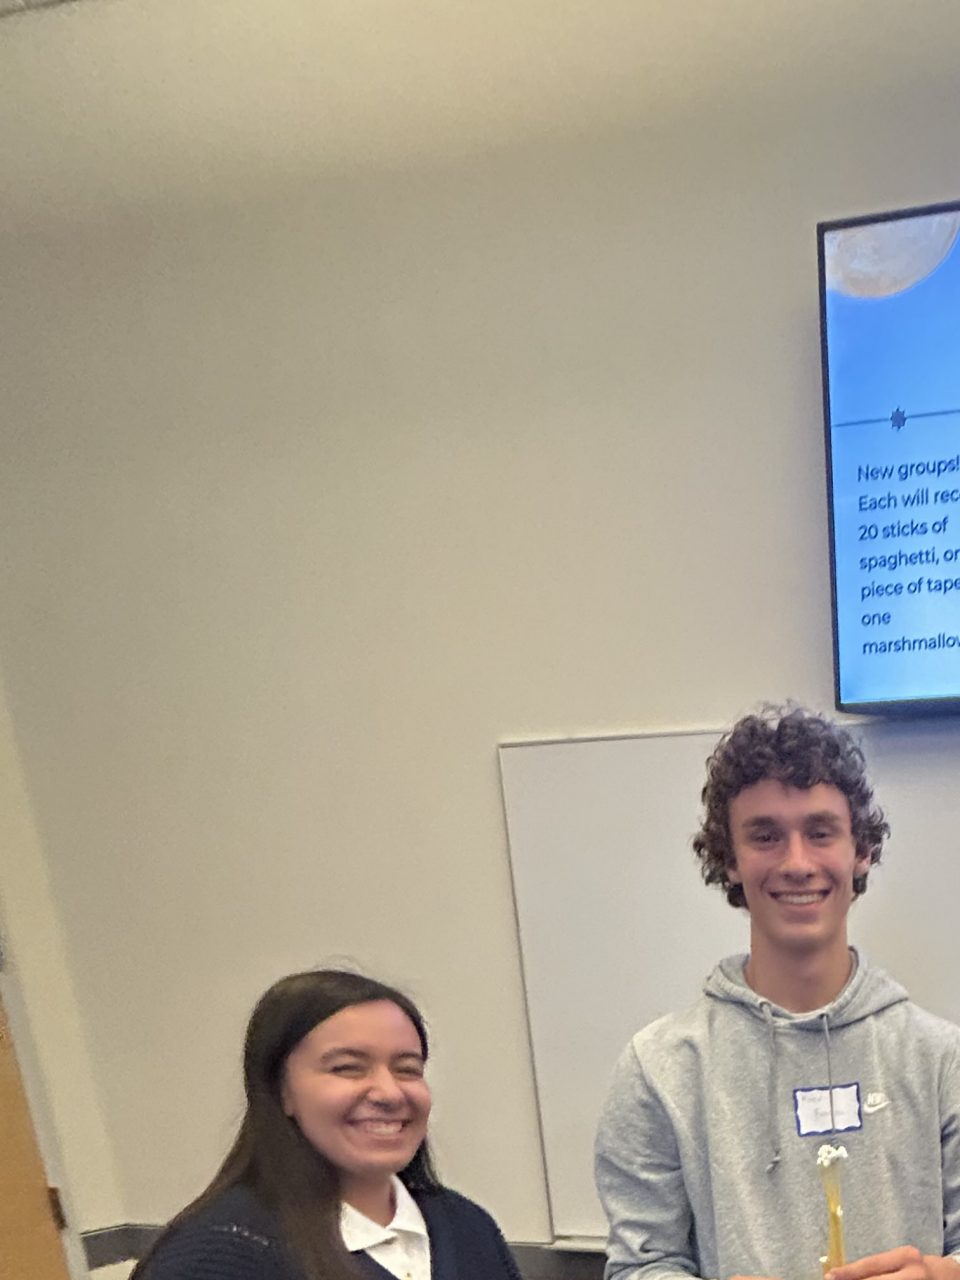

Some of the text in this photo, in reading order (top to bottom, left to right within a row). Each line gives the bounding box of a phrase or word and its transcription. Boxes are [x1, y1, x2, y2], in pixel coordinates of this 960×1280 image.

[858, 455, 960, 482] New groups!
[858, 491, 897, 512] Each
[902, 487, 929, 507] will
[858, 515, 949, 541] 20 sticks of
[859, 546, 940, 572] spaghetti,
[861, 580, 903, 602] piece
[907, 577, 924, 594] of
[861, 612, 891, 626] one
